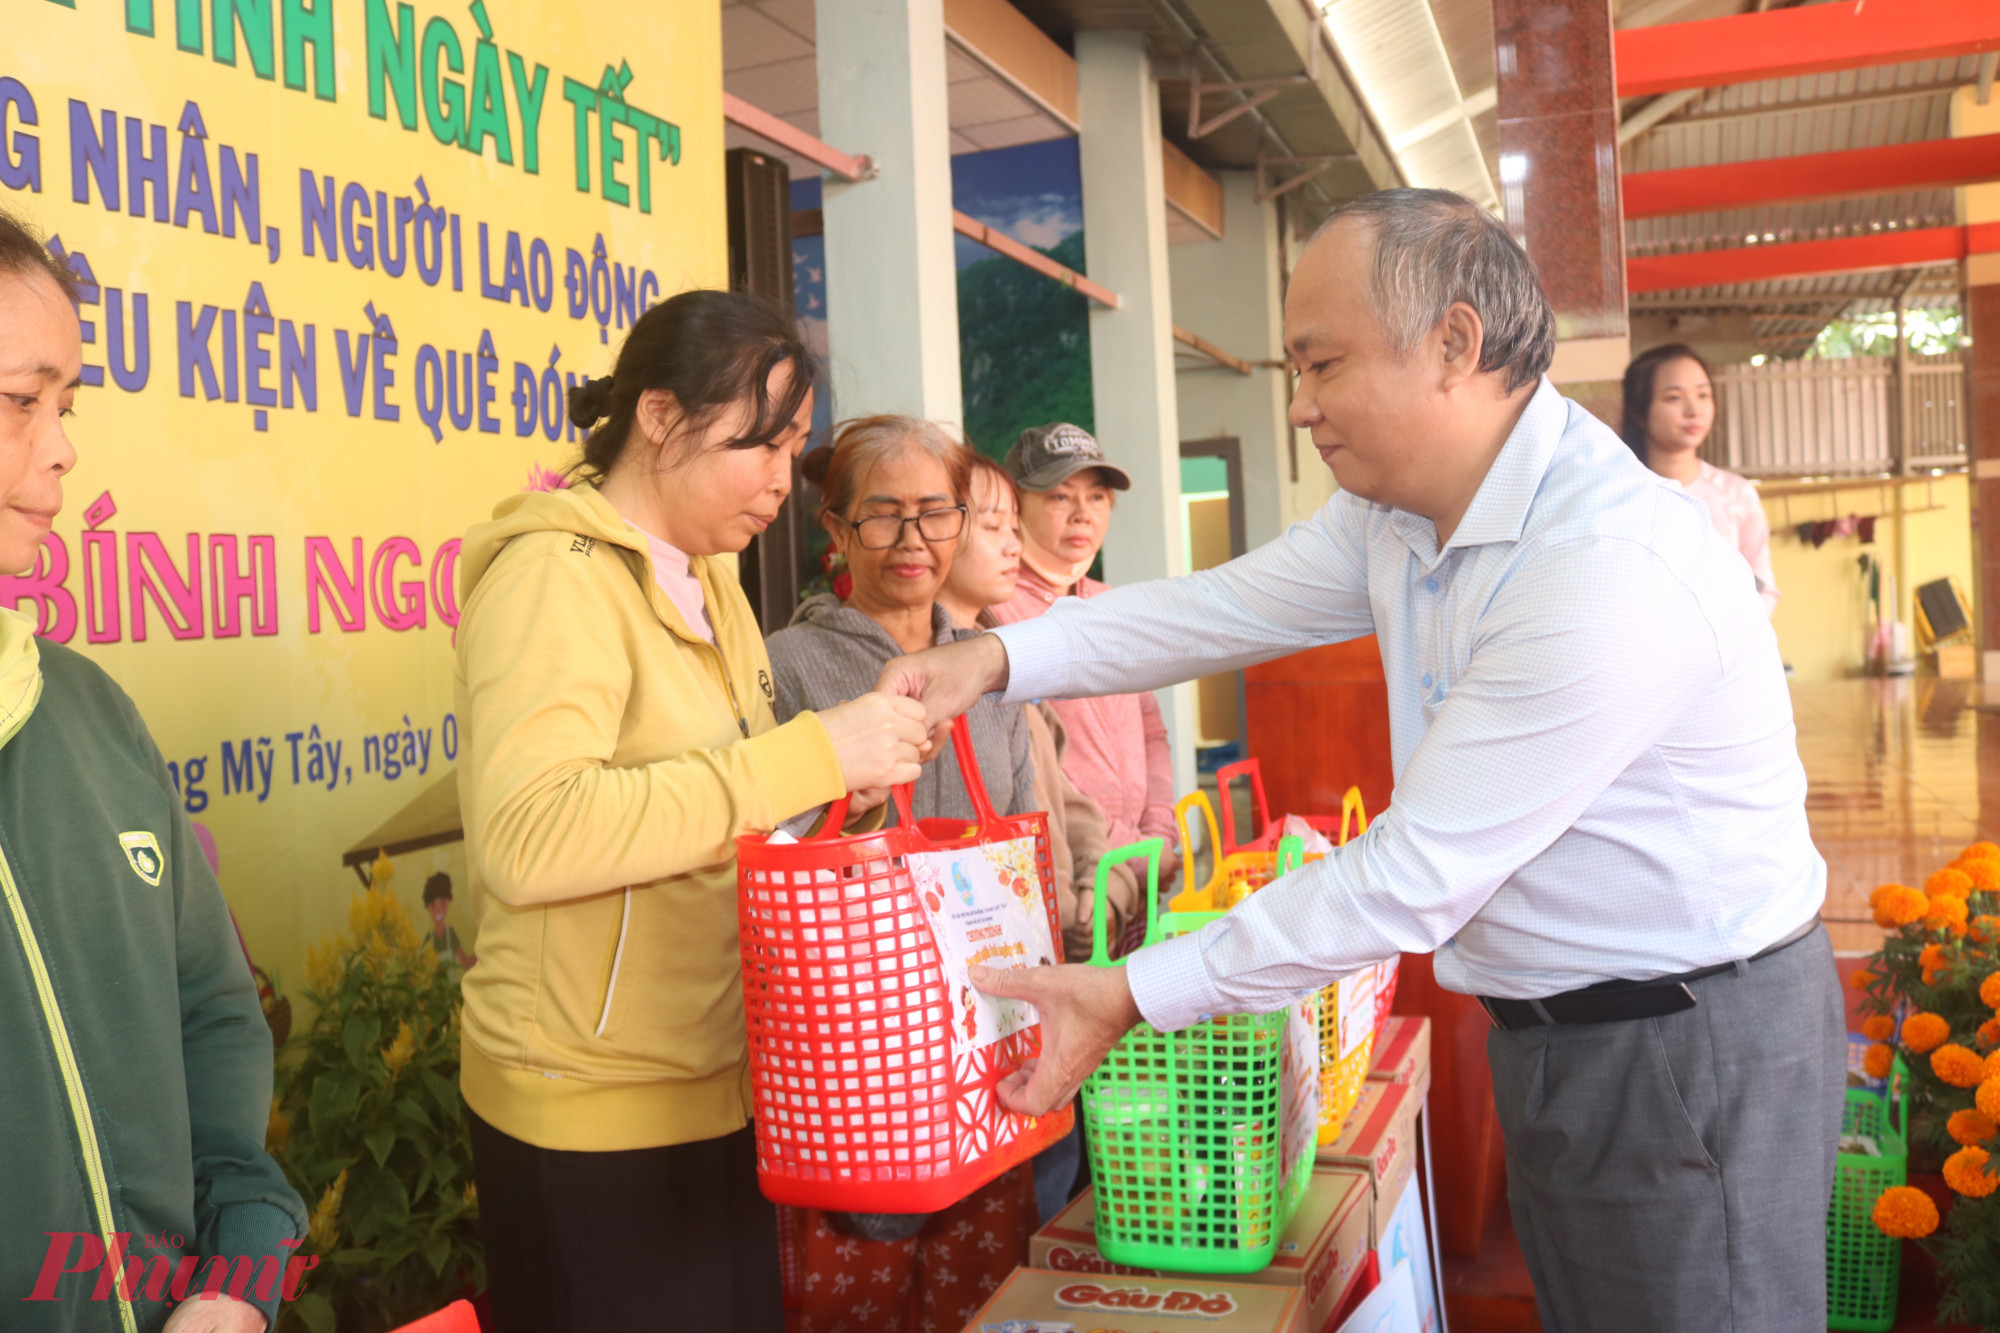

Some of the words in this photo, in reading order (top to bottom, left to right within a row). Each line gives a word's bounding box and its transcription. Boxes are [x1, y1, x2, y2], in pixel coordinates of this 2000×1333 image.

[364, 0, 549, 175] NGÀY
[67, 98, 280, 263] NHÂN,
[299, 168, 463, 292] NGƯỜI
[479, 222, 553, 313] LAO
[176, 281, 318, 432] KIỆN
[335, 301, 401, 422] VỀ
[415, 329, 500, 443] QUÊ
[220, 737, 274, 803] Mỹ
[285, 724, 353, 791] Tây,
[363, 714, 432, 780] ngày
[1058, 1284, 1162, 1310] Gấu
[1161, 1291, 1233, 1314] Đỏ
